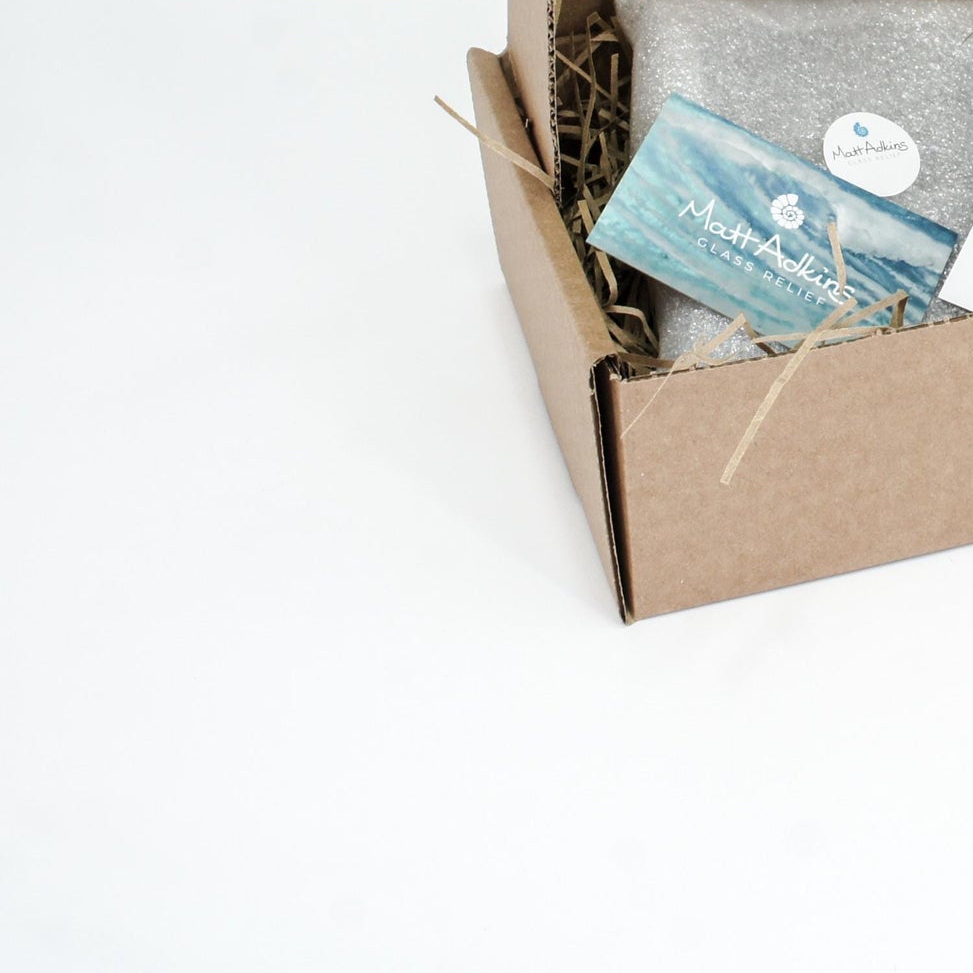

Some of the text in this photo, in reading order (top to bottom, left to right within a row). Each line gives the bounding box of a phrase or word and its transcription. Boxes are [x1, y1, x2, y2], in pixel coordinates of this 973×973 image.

[832, 140, 909, 161] Matt Adkins
[678, 198, 856, 305] Matt Adkins
[697, 237, 827, 306] GLASS RELIEF
